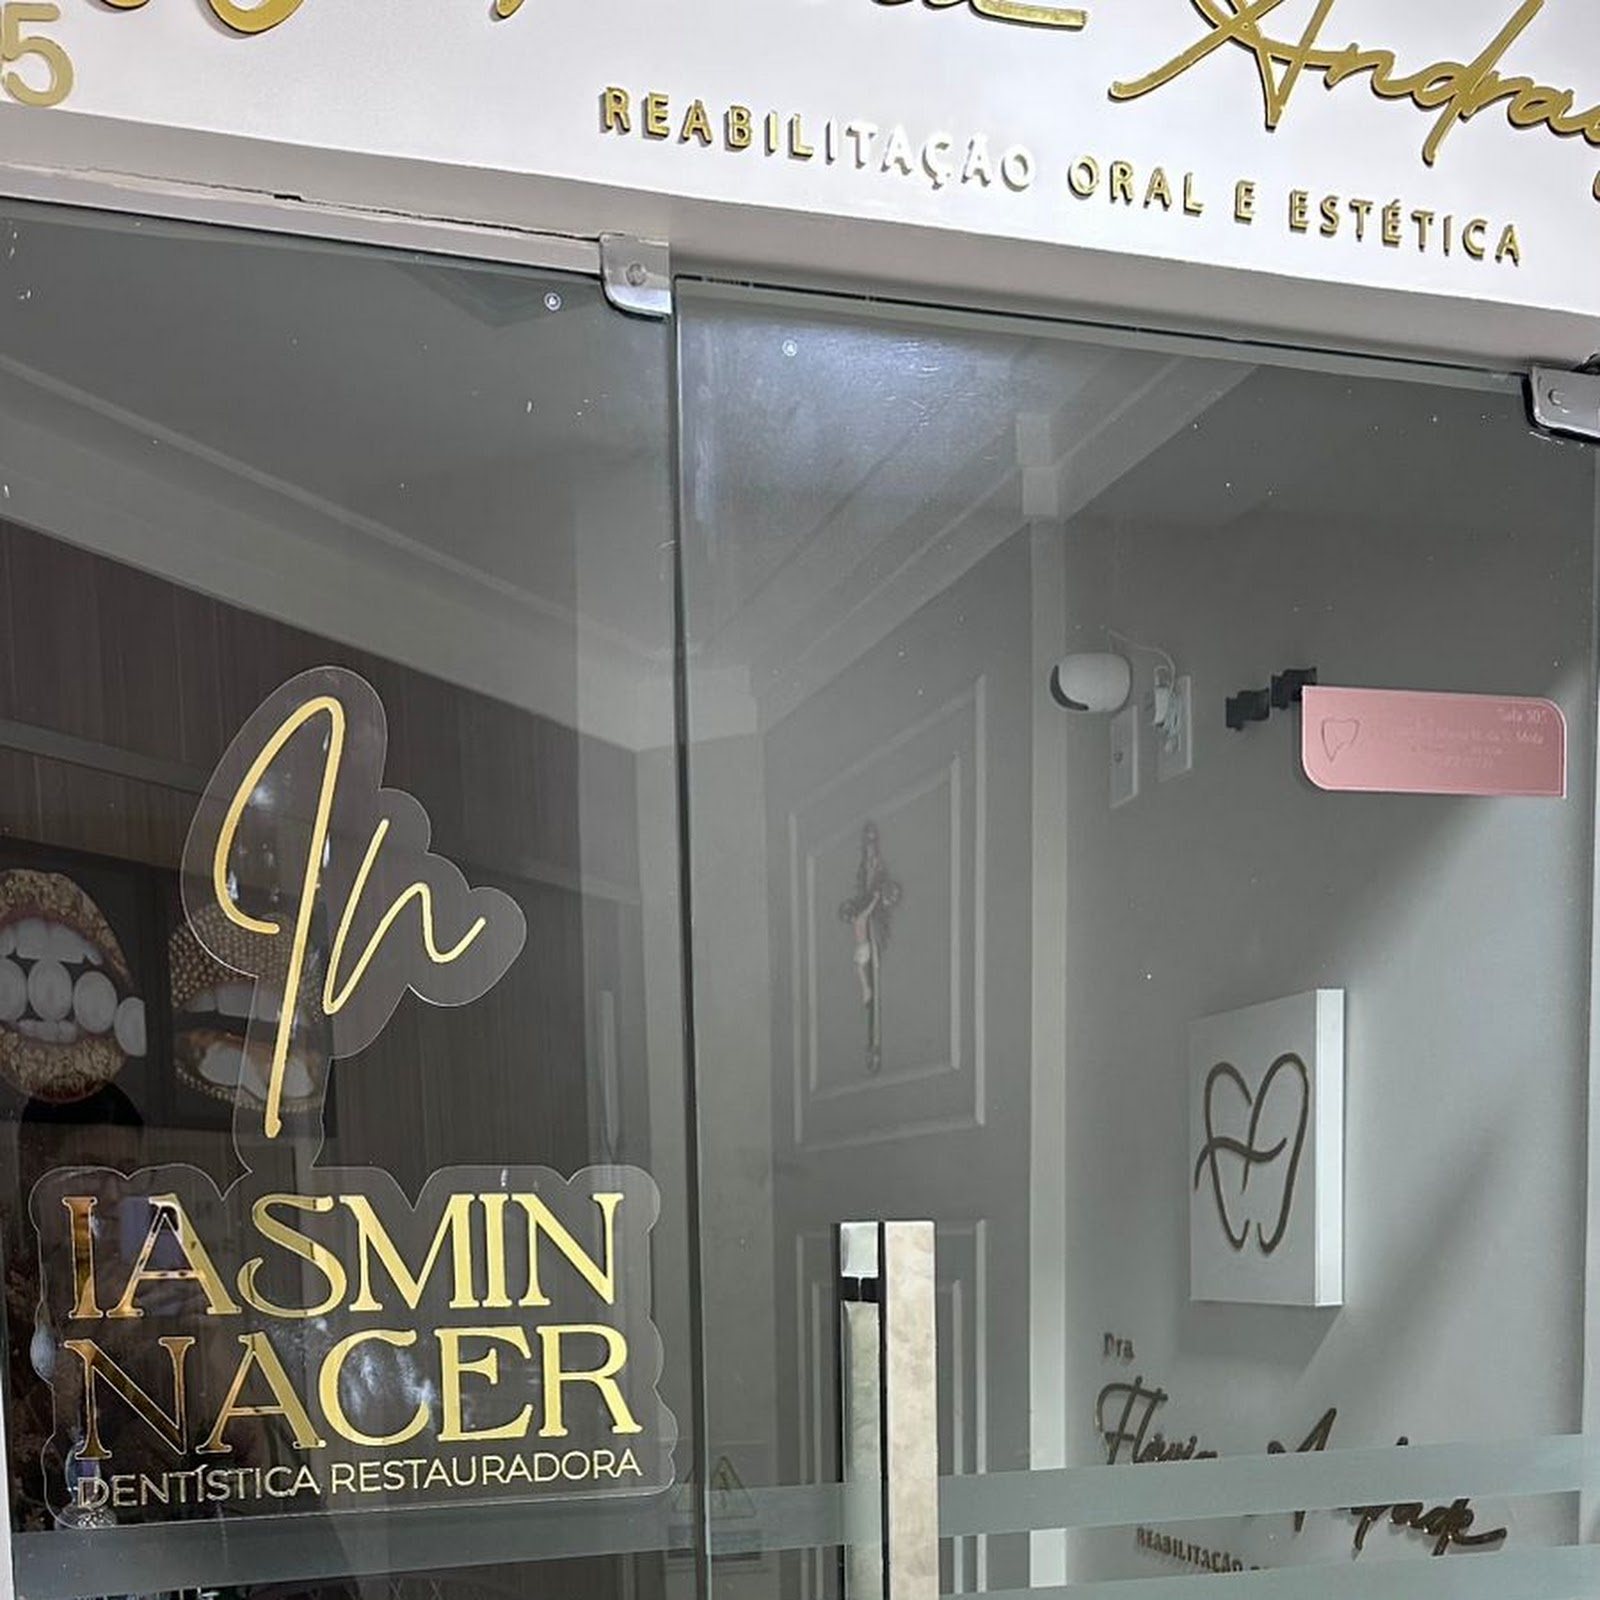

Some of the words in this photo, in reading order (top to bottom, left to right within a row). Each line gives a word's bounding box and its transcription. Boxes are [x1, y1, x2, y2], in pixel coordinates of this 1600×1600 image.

[1068, 155, 1203, 216] ORAL
[1234, 179, 1255, 224] E
[1289, 188, 1520, 267] ESTÉTICA
[62, 1193, 623, 1319] IASMIN
[64, 1324, 643, 1459] NACER
[76, 1463, 321, 1509] DENTÍSTICA
[331, 1448, 642, 1494] RESTAURADORA
